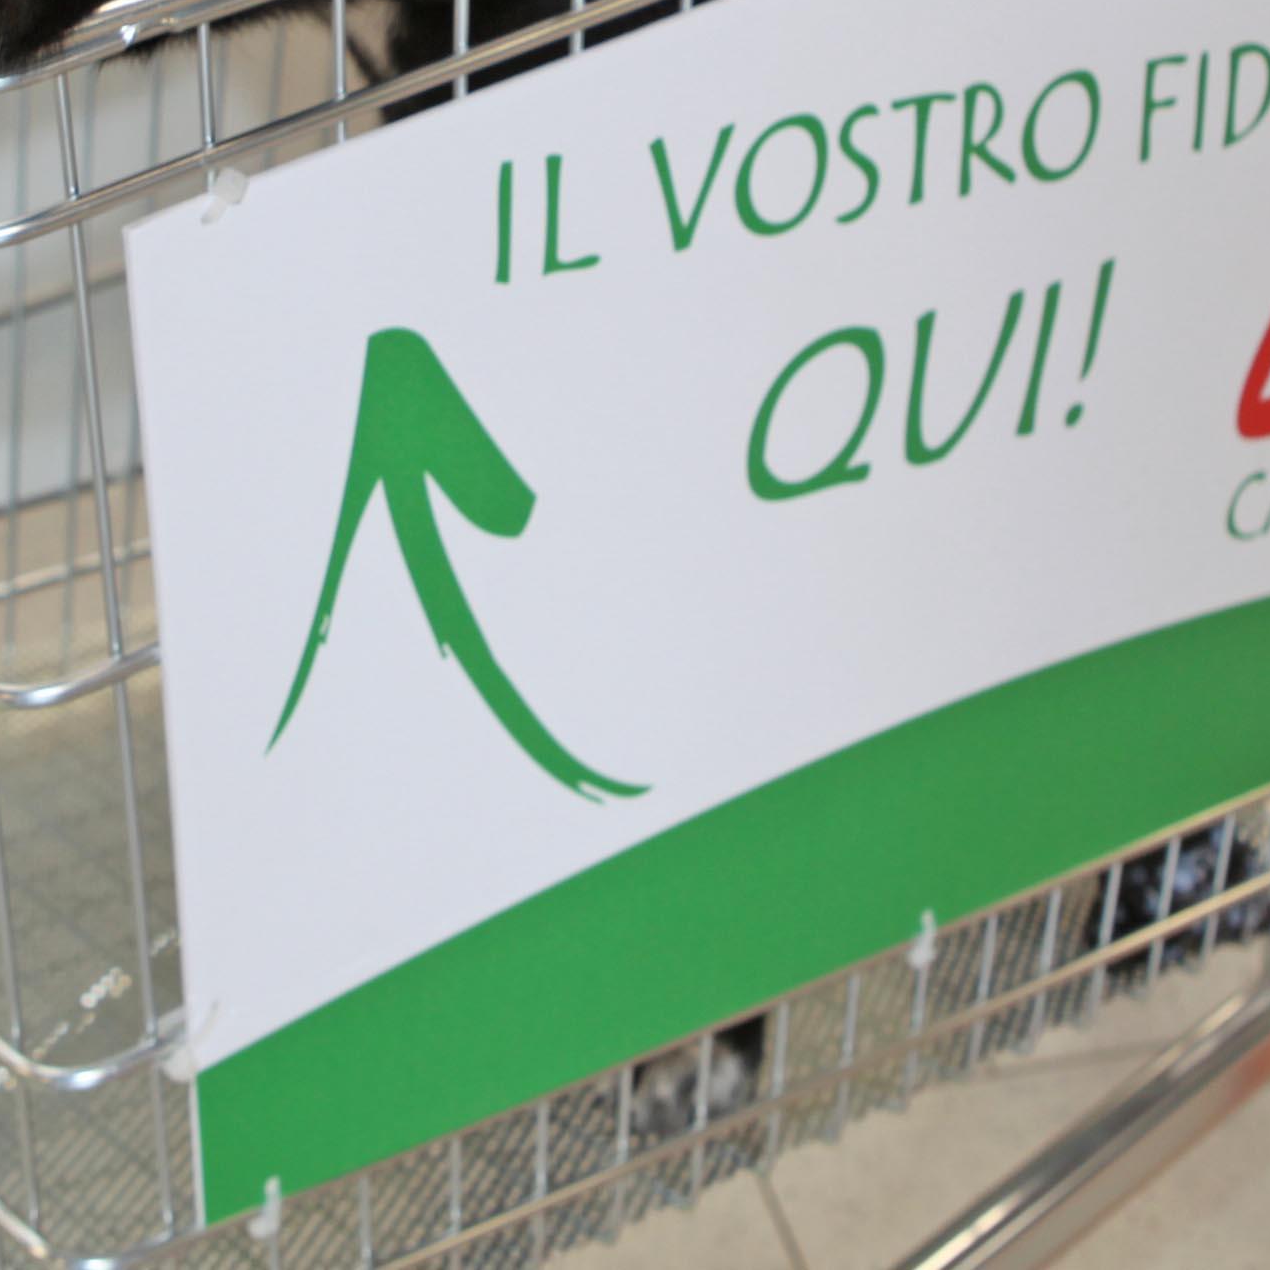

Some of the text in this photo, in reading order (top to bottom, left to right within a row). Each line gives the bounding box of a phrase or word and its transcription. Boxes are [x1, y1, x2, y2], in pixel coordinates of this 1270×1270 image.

[494, 153, 603, 285] IL
[648, 68, 1102, 254] VOSTRO
[745, 259, 1117, 504] QUI!
